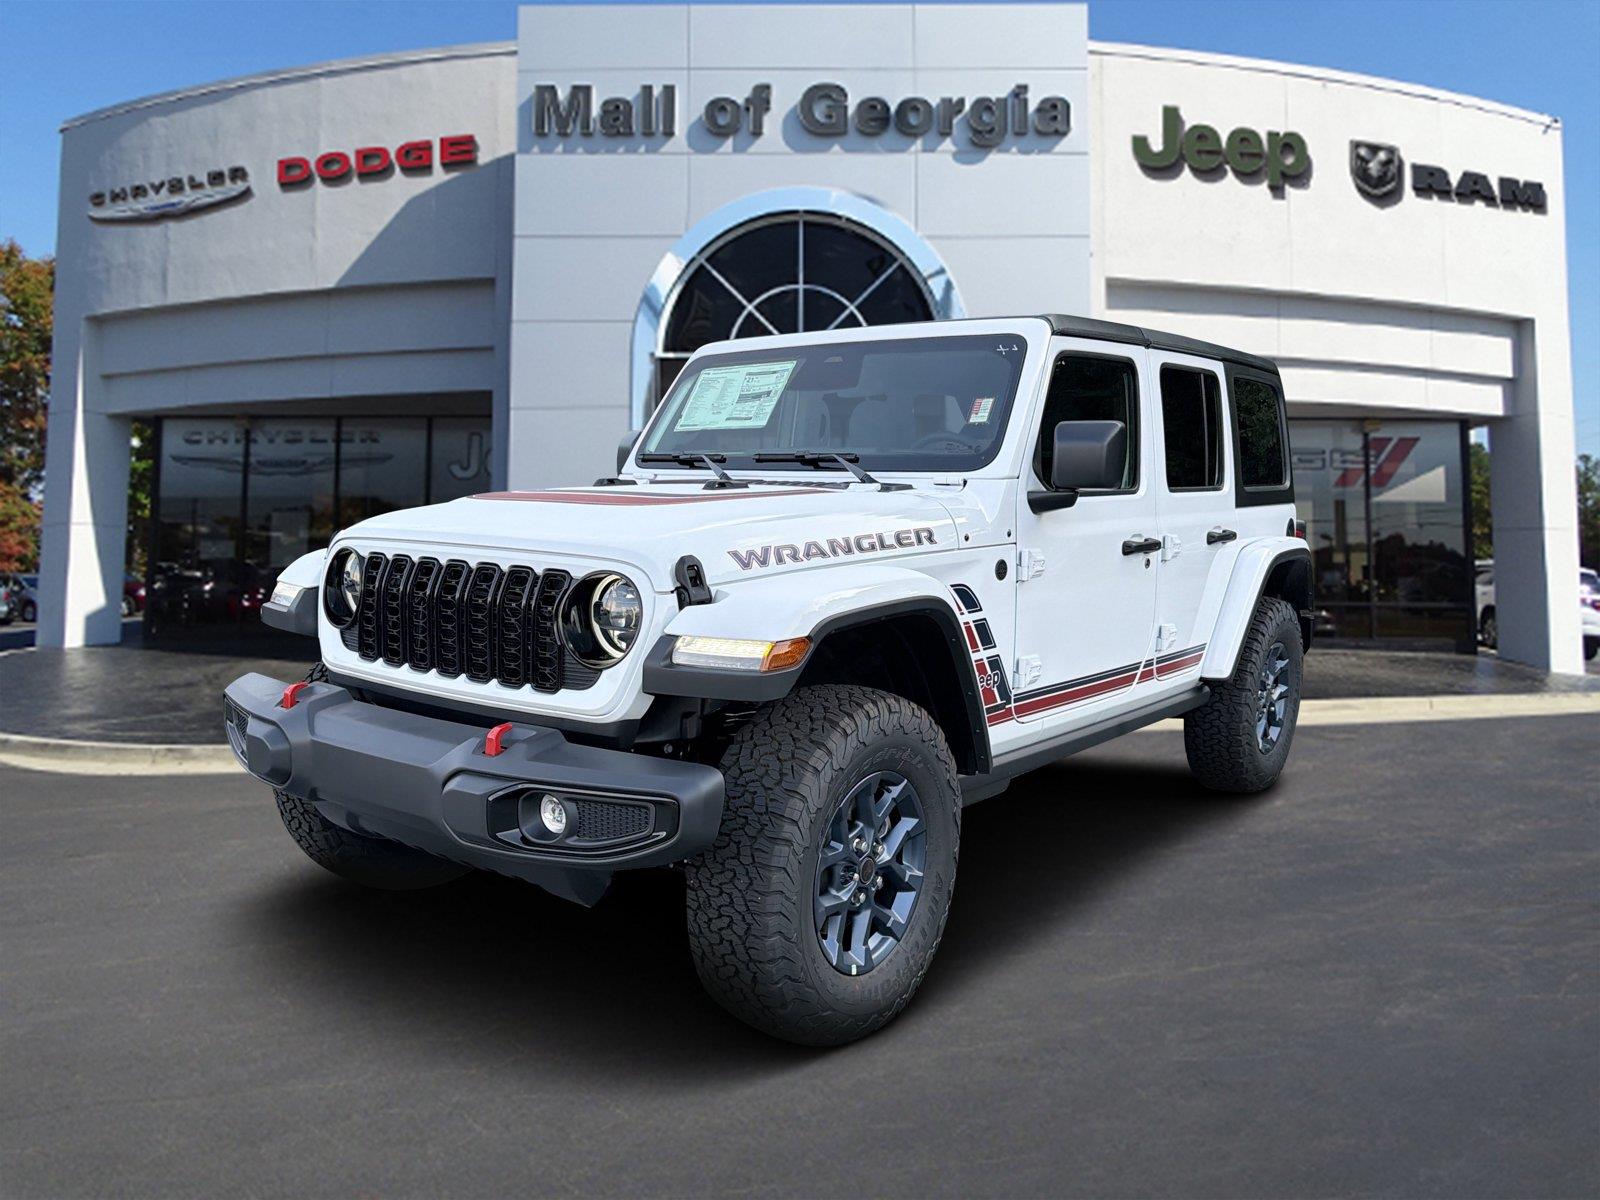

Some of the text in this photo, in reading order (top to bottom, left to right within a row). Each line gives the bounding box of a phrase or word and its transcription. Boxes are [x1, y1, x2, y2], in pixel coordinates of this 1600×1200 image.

[532, 82, 1072, 147] Mall of Georgia
[277, 134, 477, 188] DODGE
[1131, 105, 1309, 192] Jeep
[88, 166, 250, 206] CHRYSLER
[1410, 163, 1547, 213] RAM
[183, 431, 381, 444] CHRYSLER
[727, 527, 938, 571] WRANGLER
[978, 670, 1000, 690] eep
